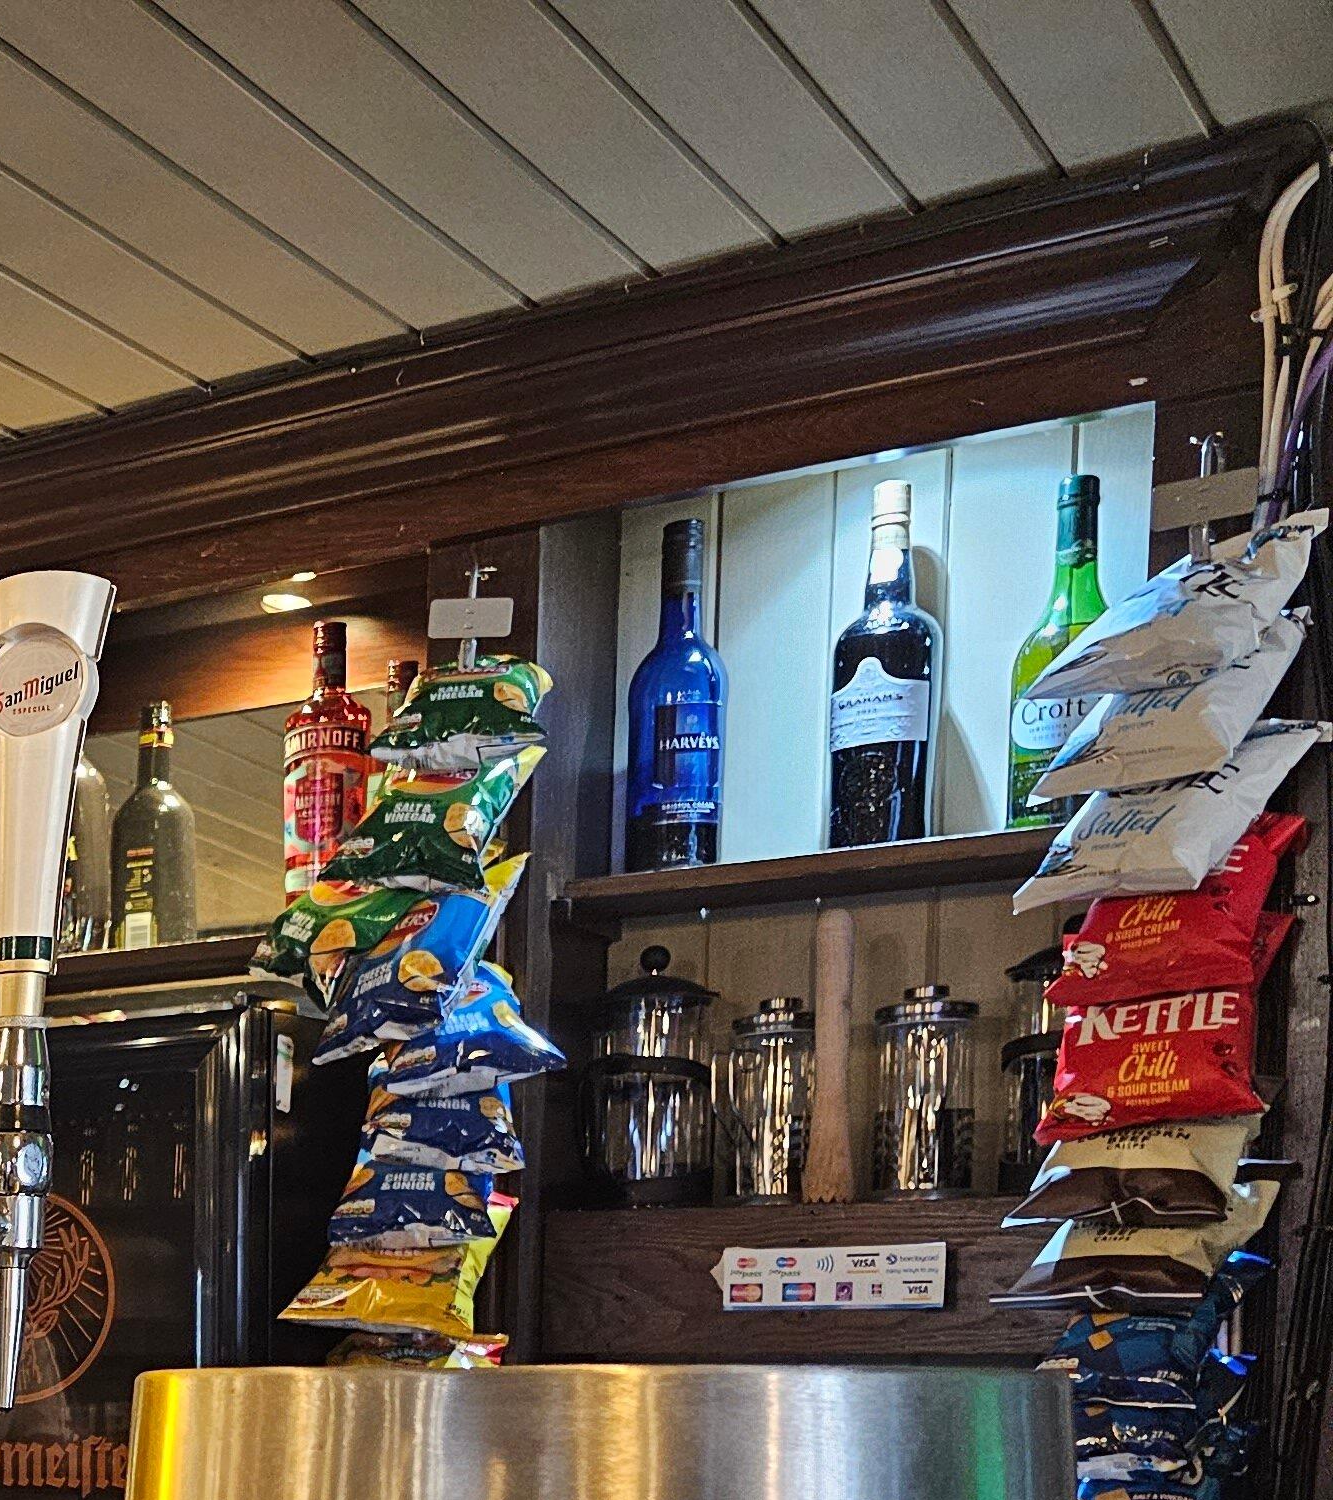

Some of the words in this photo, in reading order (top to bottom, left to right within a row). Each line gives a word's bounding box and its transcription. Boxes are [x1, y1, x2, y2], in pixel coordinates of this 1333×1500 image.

[13, 703, 51, 715] ESPECIAL
[1075, 992, 1240, 1047] KETTLE
[1132, 1040, 1170, 1052] SWEET
[1118, 1051, 1179, 1082] Chilli
[1117, 1084, 1147, 1097] SOUR
[1149, 1079, 1190, 1093] CREAM
[384, 1172, 434, 1182] CHEESE
[852, 1258, 876, 1268] VISA
[908, 1285, 929, 1295] VISA
